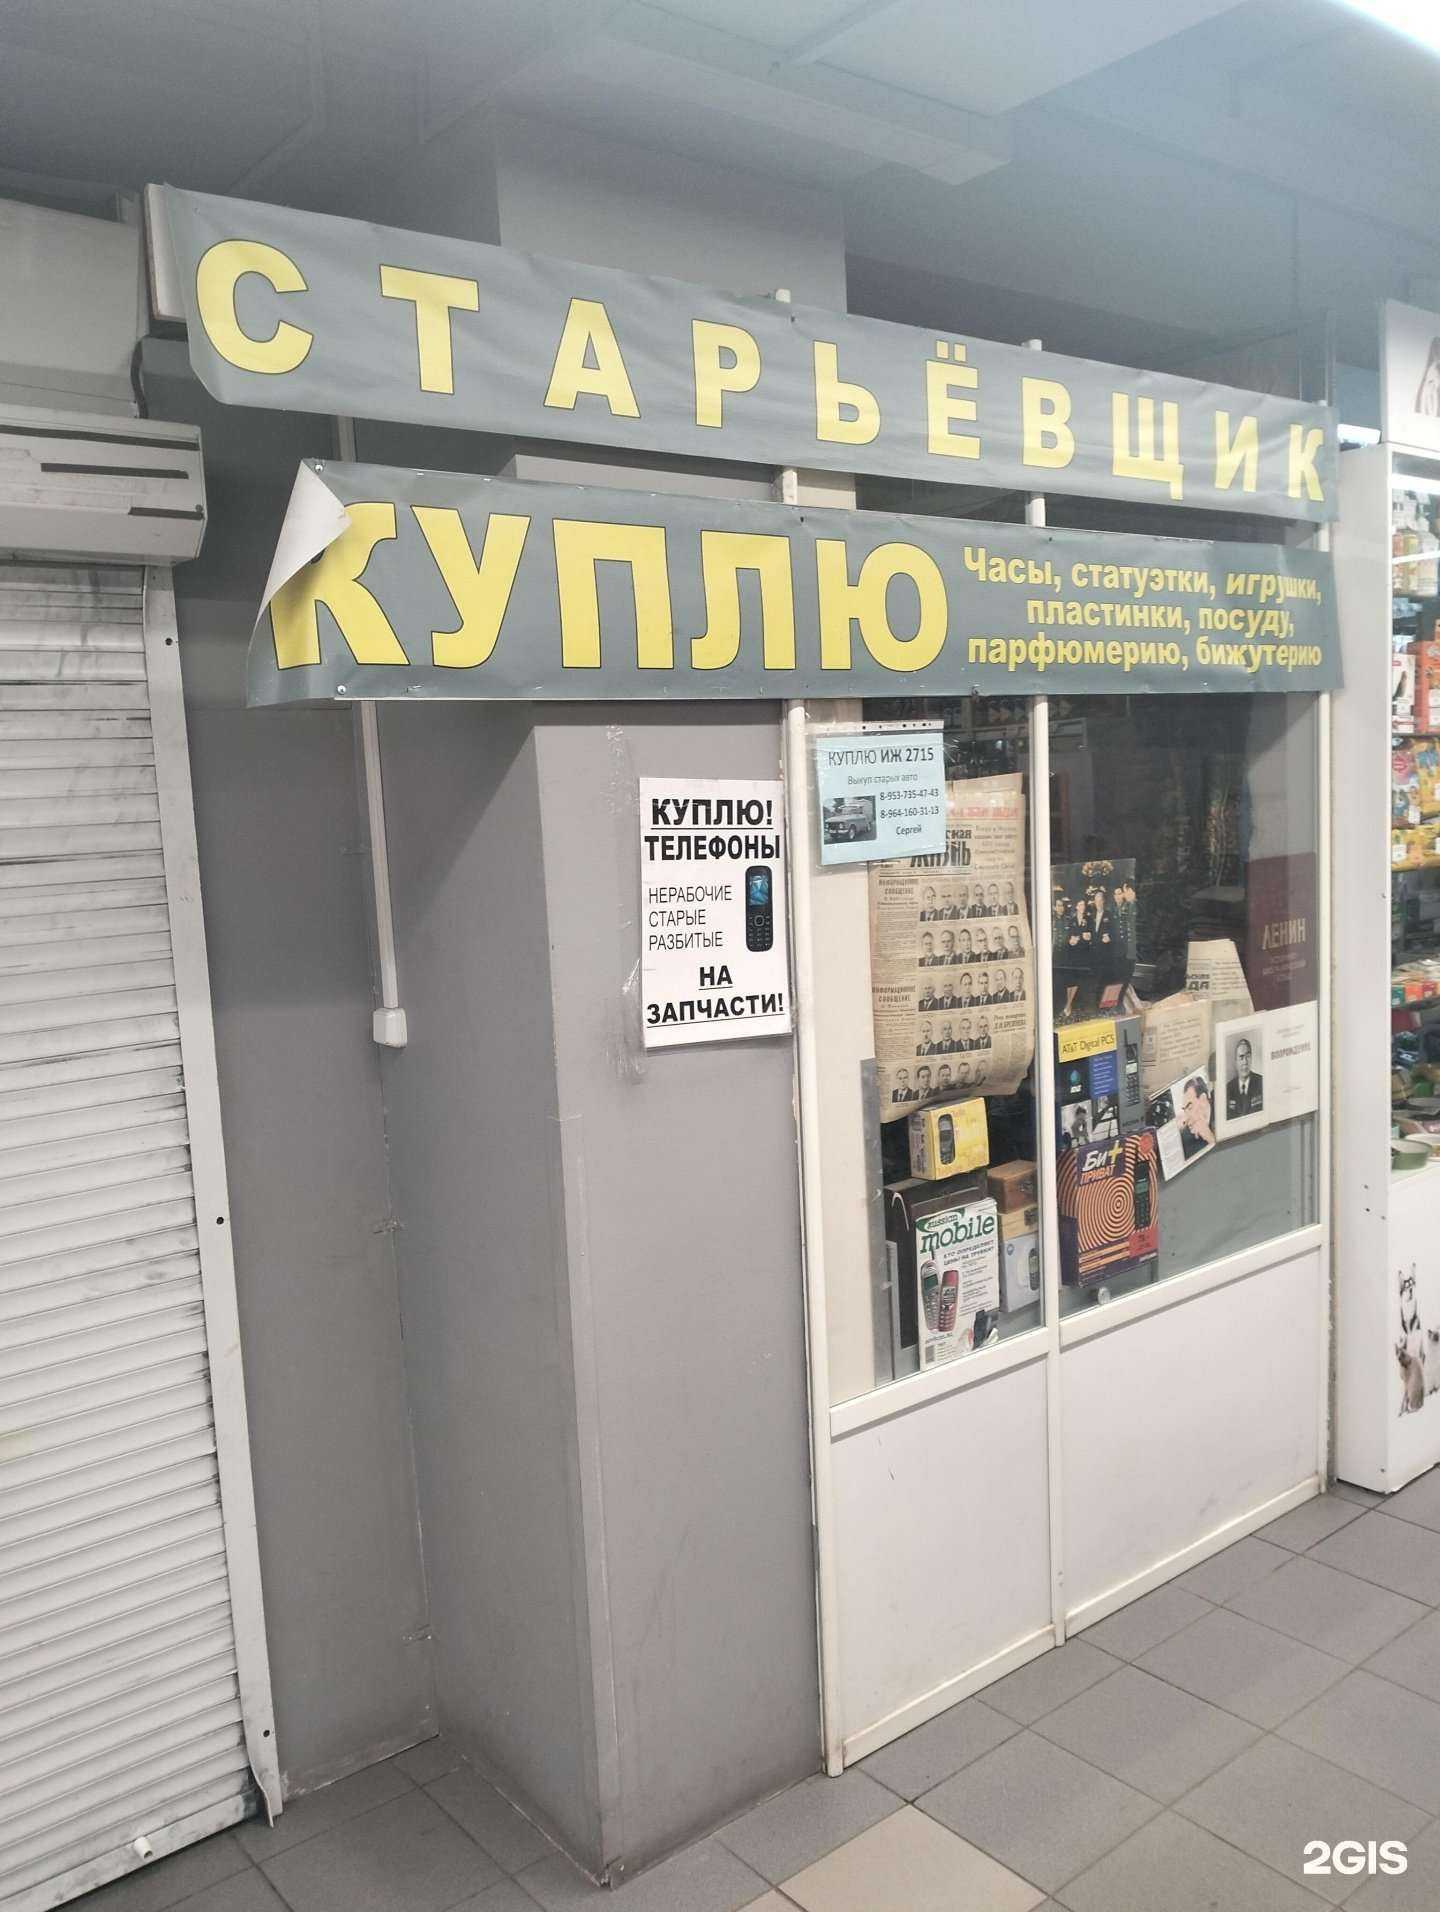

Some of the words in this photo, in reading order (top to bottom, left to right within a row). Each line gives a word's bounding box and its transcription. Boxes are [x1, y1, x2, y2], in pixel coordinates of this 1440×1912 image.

[195, 238, 1325, 502] СТАРЬЁВЩИК
[268, 500, 949, 672] КУПЛЮ
[963, 546, 1062, 592] Часы,
[1071, 561, 1216, 599] статуэтки,
[1225, 571, 1322, 605] игрушки,
[1026, 599, 1191, 634] пластинки,
[1199, 606, 1295, 638] посуду,
[967, 632, 1189, 672] парфюмерию,
[1196, 636, 1322, 673] бижутерию
[828, 750, 876, 766] КУПЛЮ
[880, 749, 902, 763] ИЖ
[906, 748, 933, 762] 2715
[848, 776, 871, 786] Выкуп
[872, 775, 899, 785] старых
[901, 774, 919, 782] авто
[652, 799, 773, 825] КУПЛЮ!
[896, 825, 922, 836] Сергей
[644, 835, 780, 860] ТЕЛЕФОНЫ
[649, 885, 732, 904] НЕРАБОЧИЕ
[649, 909, 706, 927] СТАРЫЕ
[649, 932, 723, 951] РАЗБИТЫЕ
[1262, 918, 1307, 950] ЛЕНИН
[699, 965, 733, 987] НА
[647, 993, 784, 1024] ЗАПЧАСТИ!
[920, 1215, 994, 1254] mobile
